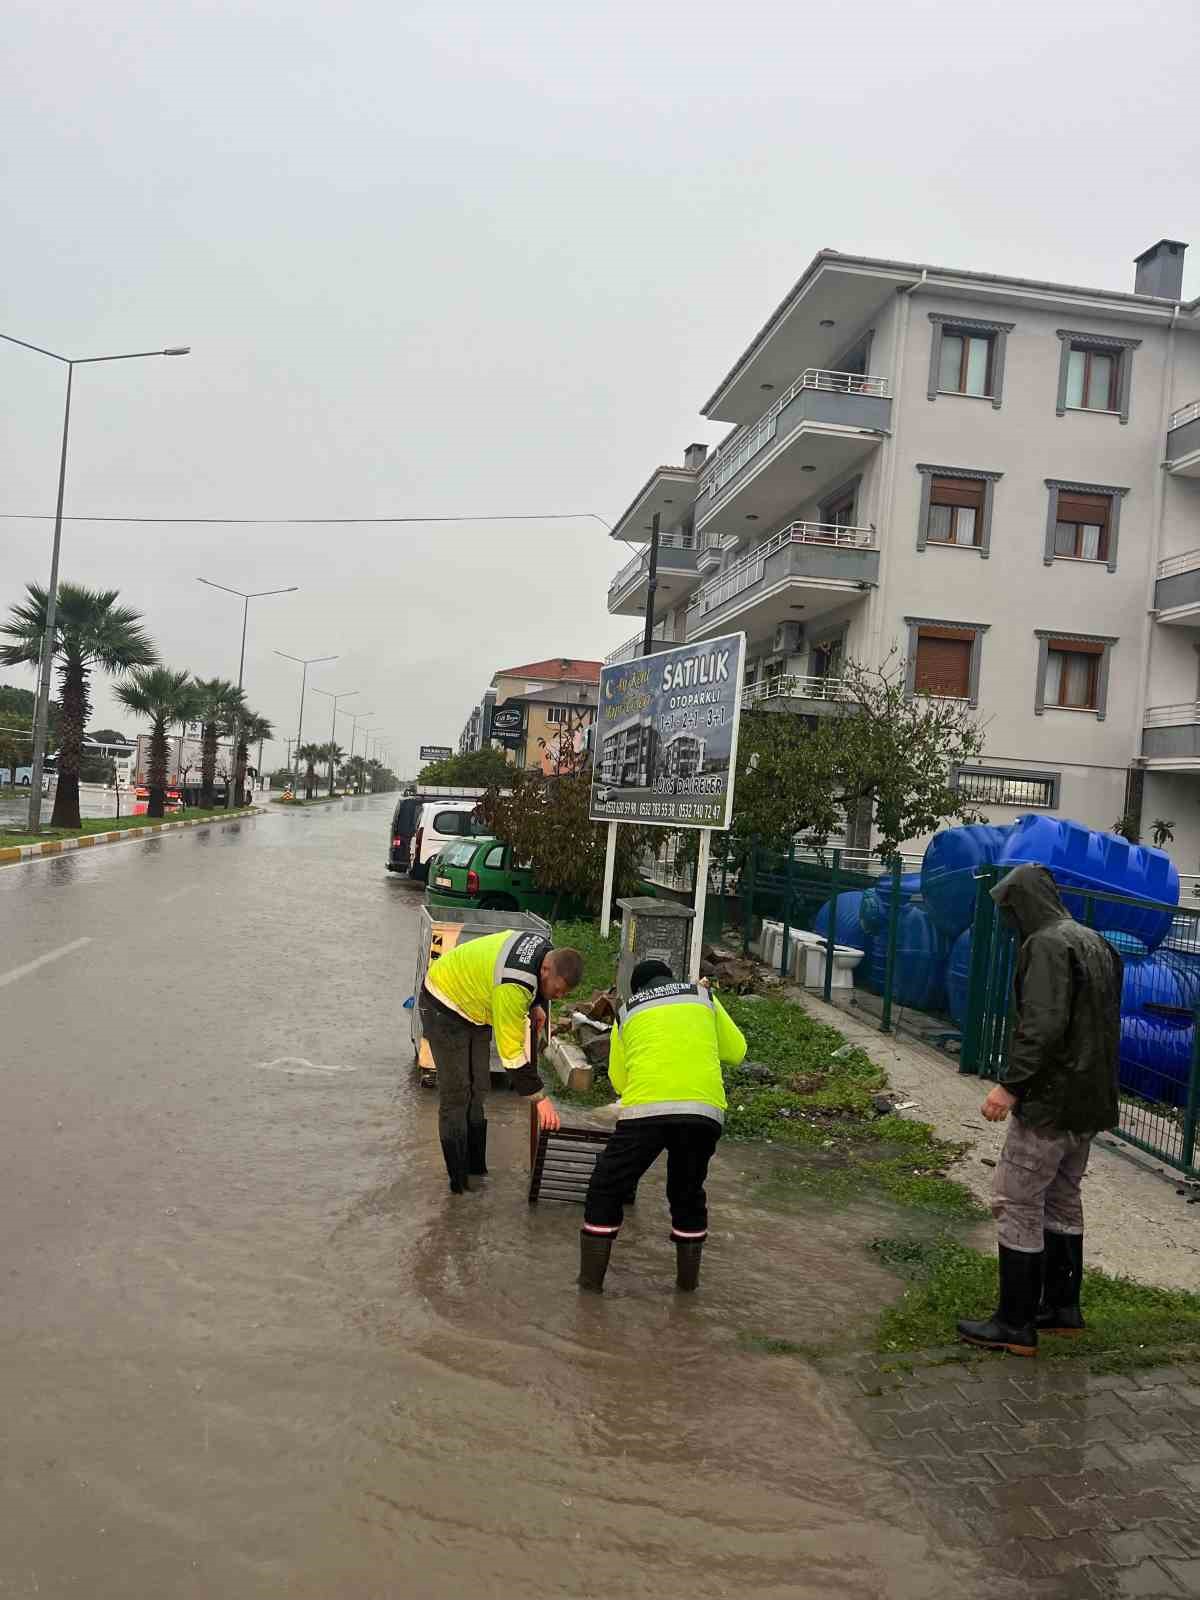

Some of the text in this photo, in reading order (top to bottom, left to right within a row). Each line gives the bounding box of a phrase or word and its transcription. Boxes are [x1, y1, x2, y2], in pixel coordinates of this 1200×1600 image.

[662, 651, 729, 691] SATILIK
[670, 690, 720, 708] OTOPARKLI
[682, 711, 698, 729] 2+1
[706, 706, 725, 727] 3+1
[679, 803, 692, 818] 0532
[704, 804, 712, 819] 72
[712, 804, 721, 820] 47
